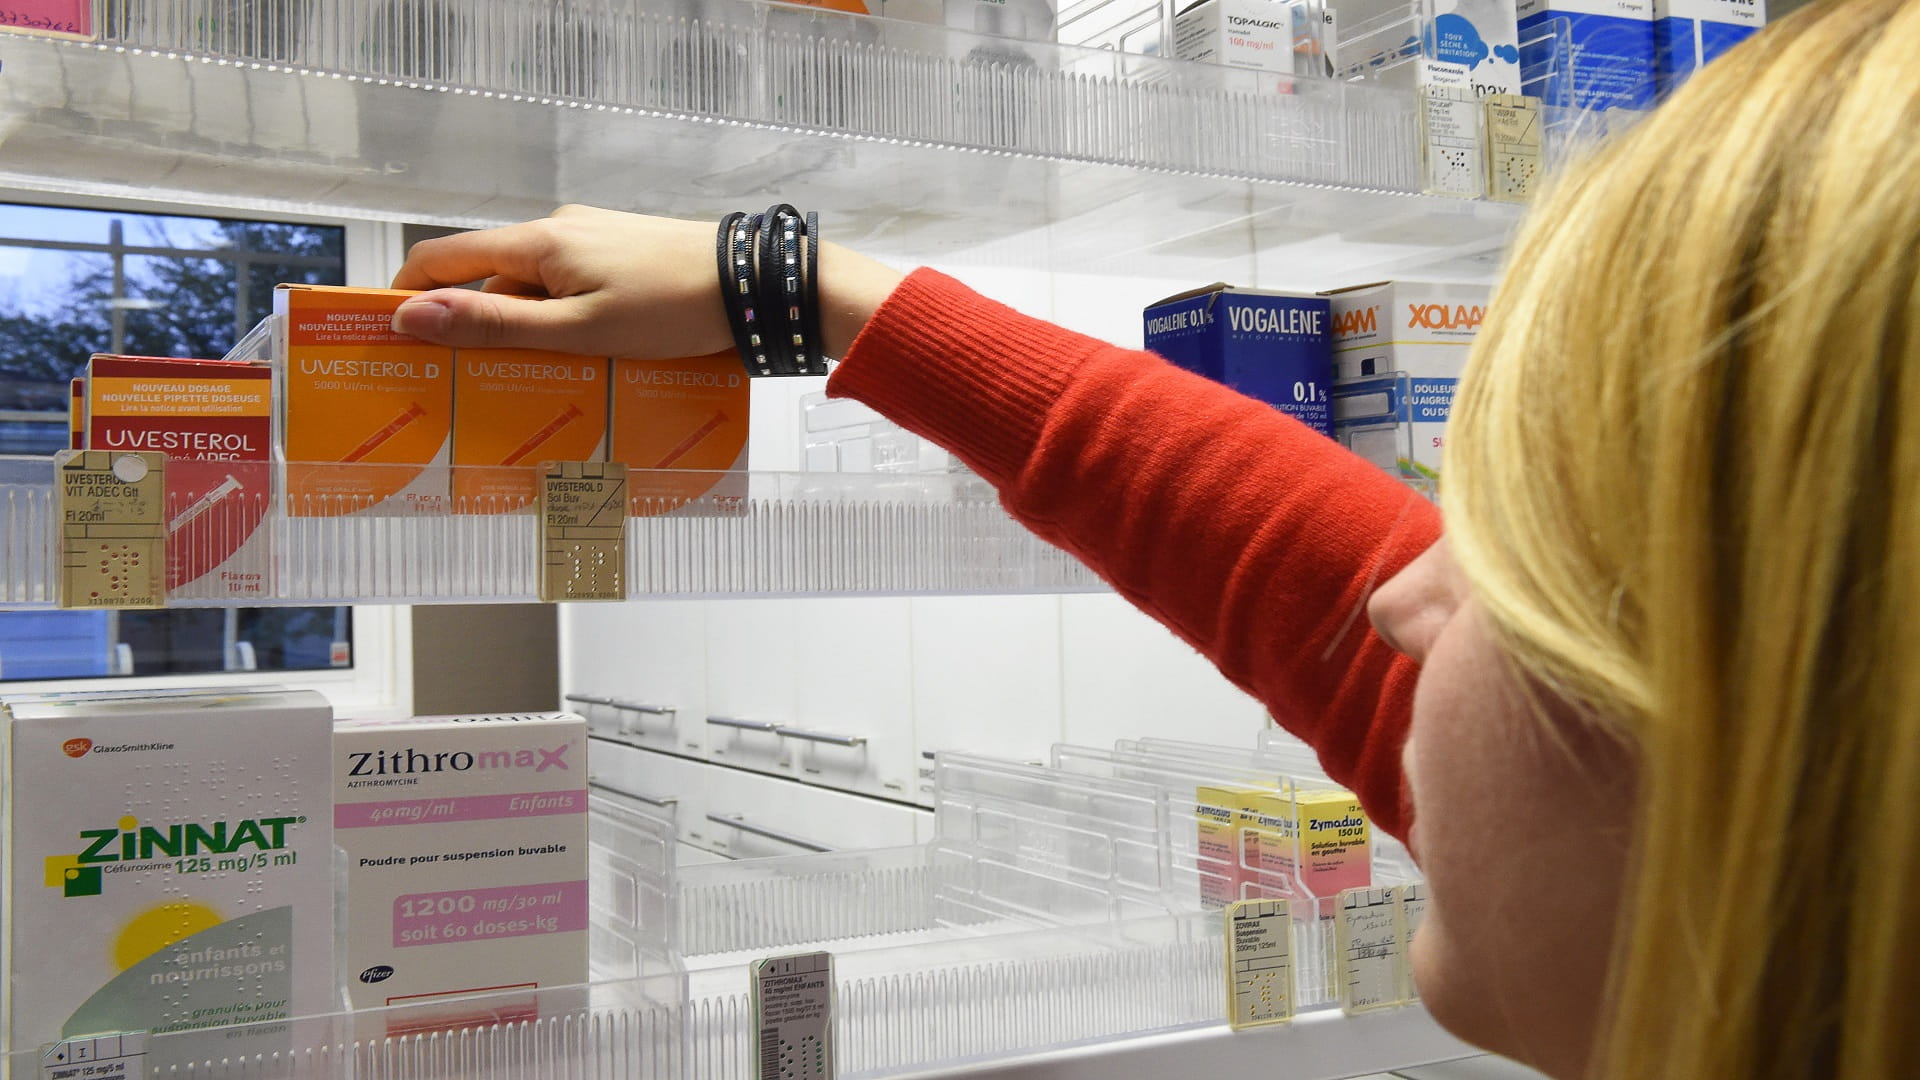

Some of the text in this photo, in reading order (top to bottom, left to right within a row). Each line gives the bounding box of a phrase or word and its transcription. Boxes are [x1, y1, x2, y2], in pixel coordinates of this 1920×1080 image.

[1227, 15, 1280, 30] TOPALGIC
[326, 313, 375, 322] NOUVEAU
[299, 323, 391, 332] NOUVELLE PIPETT
[316, 333, 332, 341] Lire
[300, 359, 440, 380] UVESTEROL D
[467, 361, 596, 382] UVESTEROL D
[624, 368, 740, 388] UVESTEROL D
[133, 383, 231, 393] NOUVEAU DOSAGE
[1293, 382, 1315, 404] 0,1
[102, 393, 261, 403] NOUVELLE PIPETTE DOSEUSE
[1419, 396, 1452, 405] AIGREU
[121, 404, 243, 413] Lire la notice avant utilisation
[105, 429, 256, 451] UVESTEROL
[65, 473, 127, 486] UVESTERO
[547, 482, 603, 493] UVESTEROL D
[65, 486, 85, 497] VIT
[87, 486, 121, 498] ADEC
[64, 742, 88, 753] gsk
[93, 742, 174, 753] GlaxoSmithKline
[348, 743, 569, 776] Zithromax
[347, 778, 418, 788] AZITHROMYCINE
[370, 795, 574, 822] 40mg/ml Enfants
[1309, 815, 1363, 832] Zymaduo
[1338, 827, 1363, 837] 150 UI
[1311, 842, 1338, 850] Solution
[104, 851, 296, 875] Céfuroxime 125 mg/5 ml
[359, 843, 566, 867] Poudre pour suspension buvable
[400, 891, 562, 918] 1200 mg/30 ml
[401, 914, 559, 943] soit 60 doses-kg
[177, 944, 285, 966] enfants et
[150, 959, 286, 985] nourrissons
[362, 968, 394, 984] Pfizer
[191, 999, 287, 1019] granulés pour
[152, 1010, 287, 1034] suspension buvable
